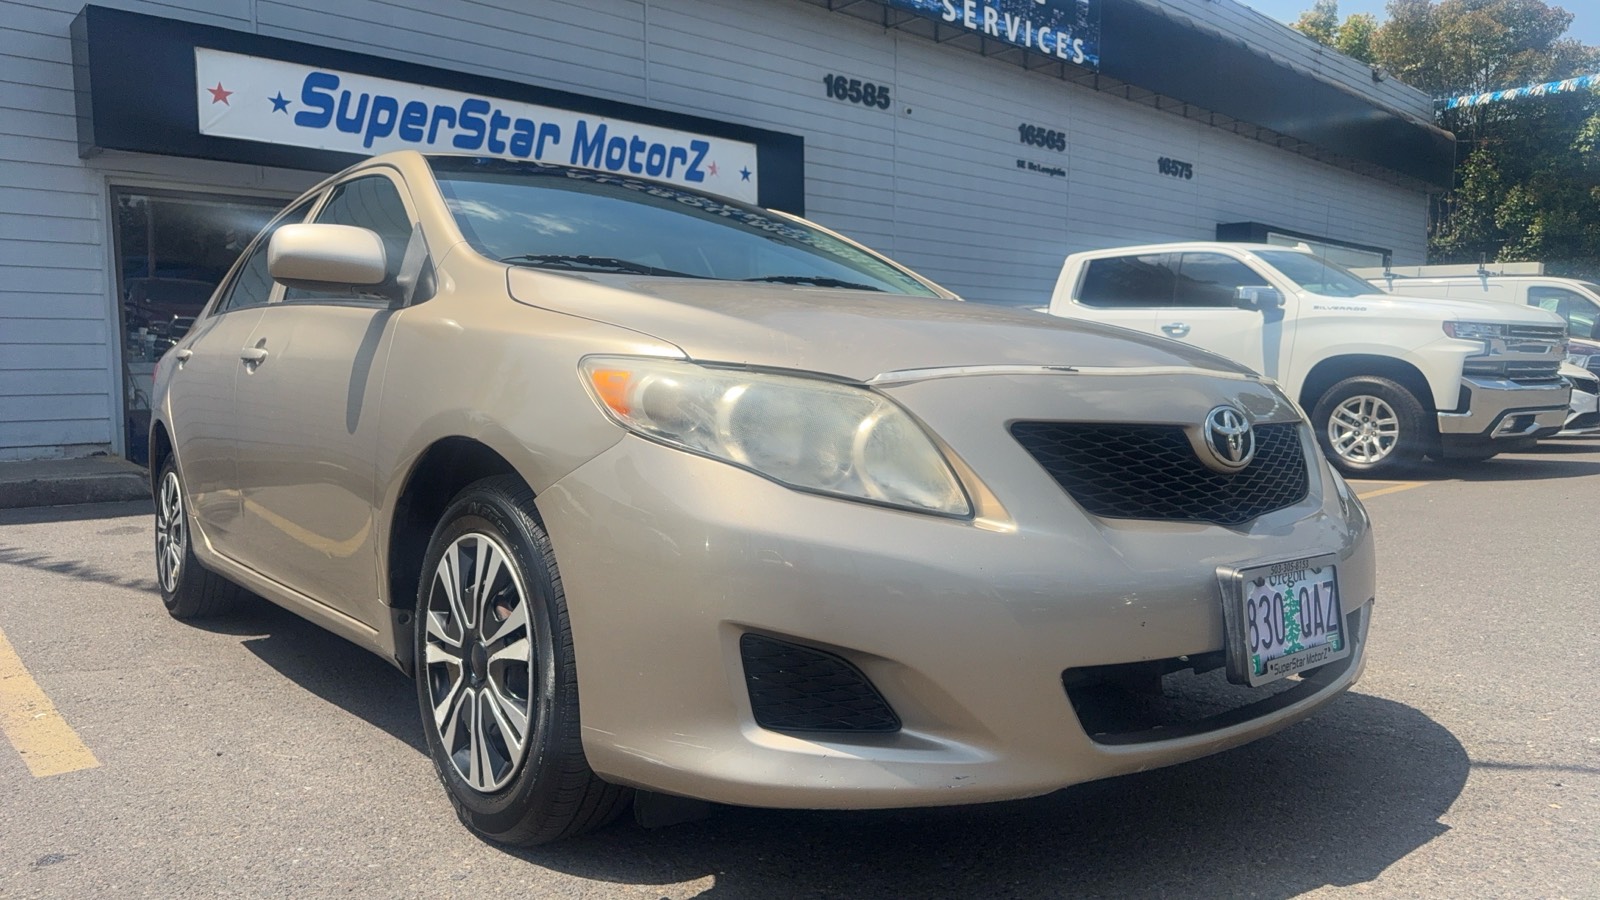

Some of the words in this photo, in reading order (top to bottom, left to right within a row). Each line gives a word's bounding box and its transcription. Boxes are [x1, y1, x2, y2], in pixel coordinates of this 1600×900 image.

[942, 0, 1084, 65] SERVICES
[823, 73, 891, 110] 16585
[294, 71, 561, 160] SuperStar
[570, 120, 710, 182] MotorZ
[1018, 123, 1066, 152] 16565
[1157, 156, 1193, 180] 16575
[1313, 304, 1368, 312] SILVERADO
[1269, 569, 1307, 588] Oregon
[1247, 592, 1286, 654] 830
[1299, 580, 1338, 638] QAZ
[1274, 656, 1306, 676] SuperStar
[1306, 647, 1328, 665] MotorZ
